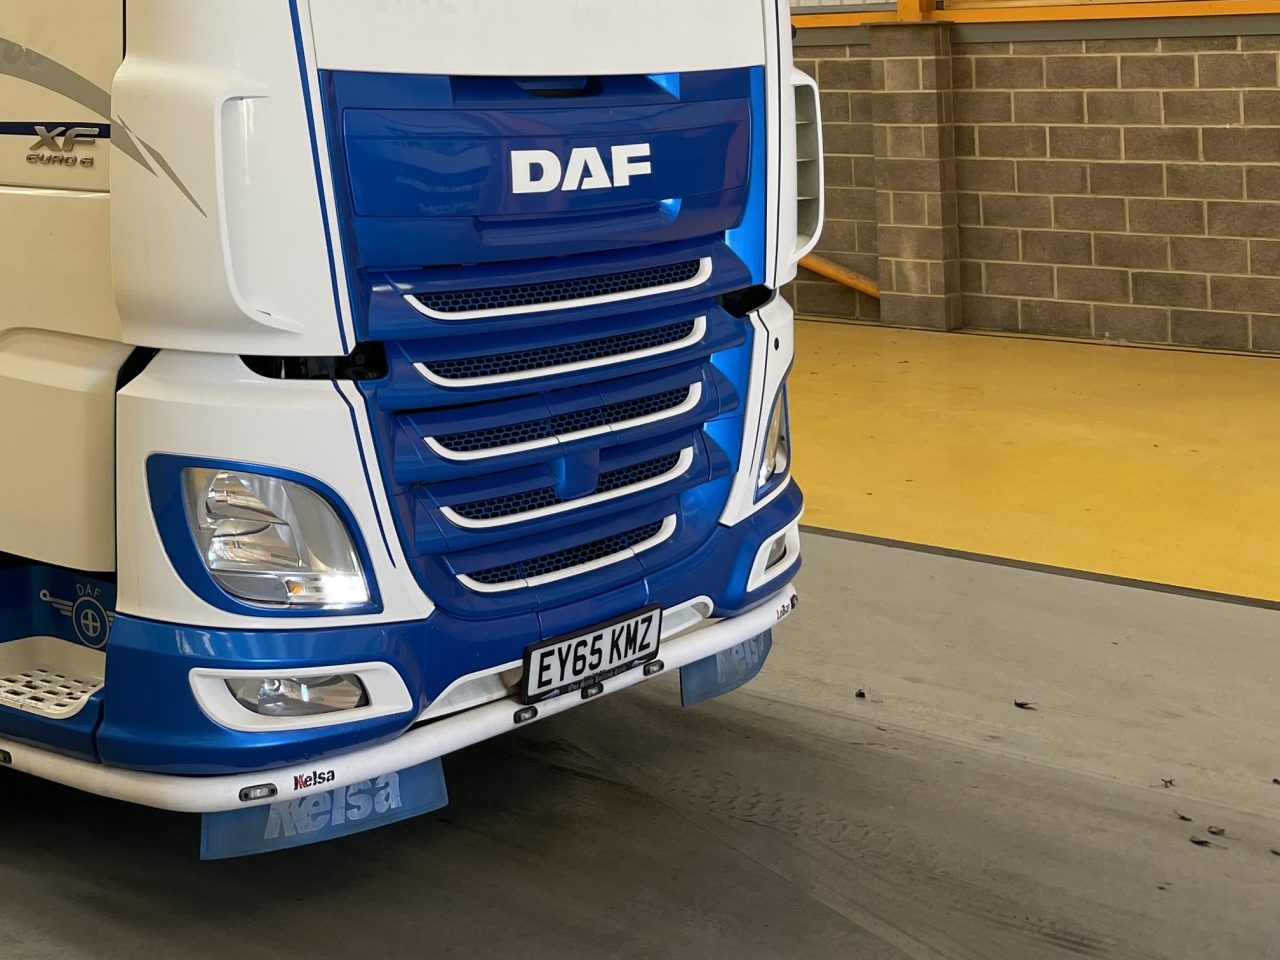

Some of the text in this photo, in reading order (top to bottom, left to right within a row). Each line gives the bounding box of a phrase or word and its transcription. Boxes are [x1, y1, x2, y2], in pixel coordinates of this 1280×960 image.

[29, 125, 100, 153] XF
[25, 152, 78, 167] EURO
[510, 142, 652, 194] DAF
[76, 583, 101, 598] DAF
[537, 633, 604, 689] EY65
[608, 614, 653, 665] KMZ
[293, 769, 336, 791] Kelsa
[263, 770, 403, 840] Kelsa
